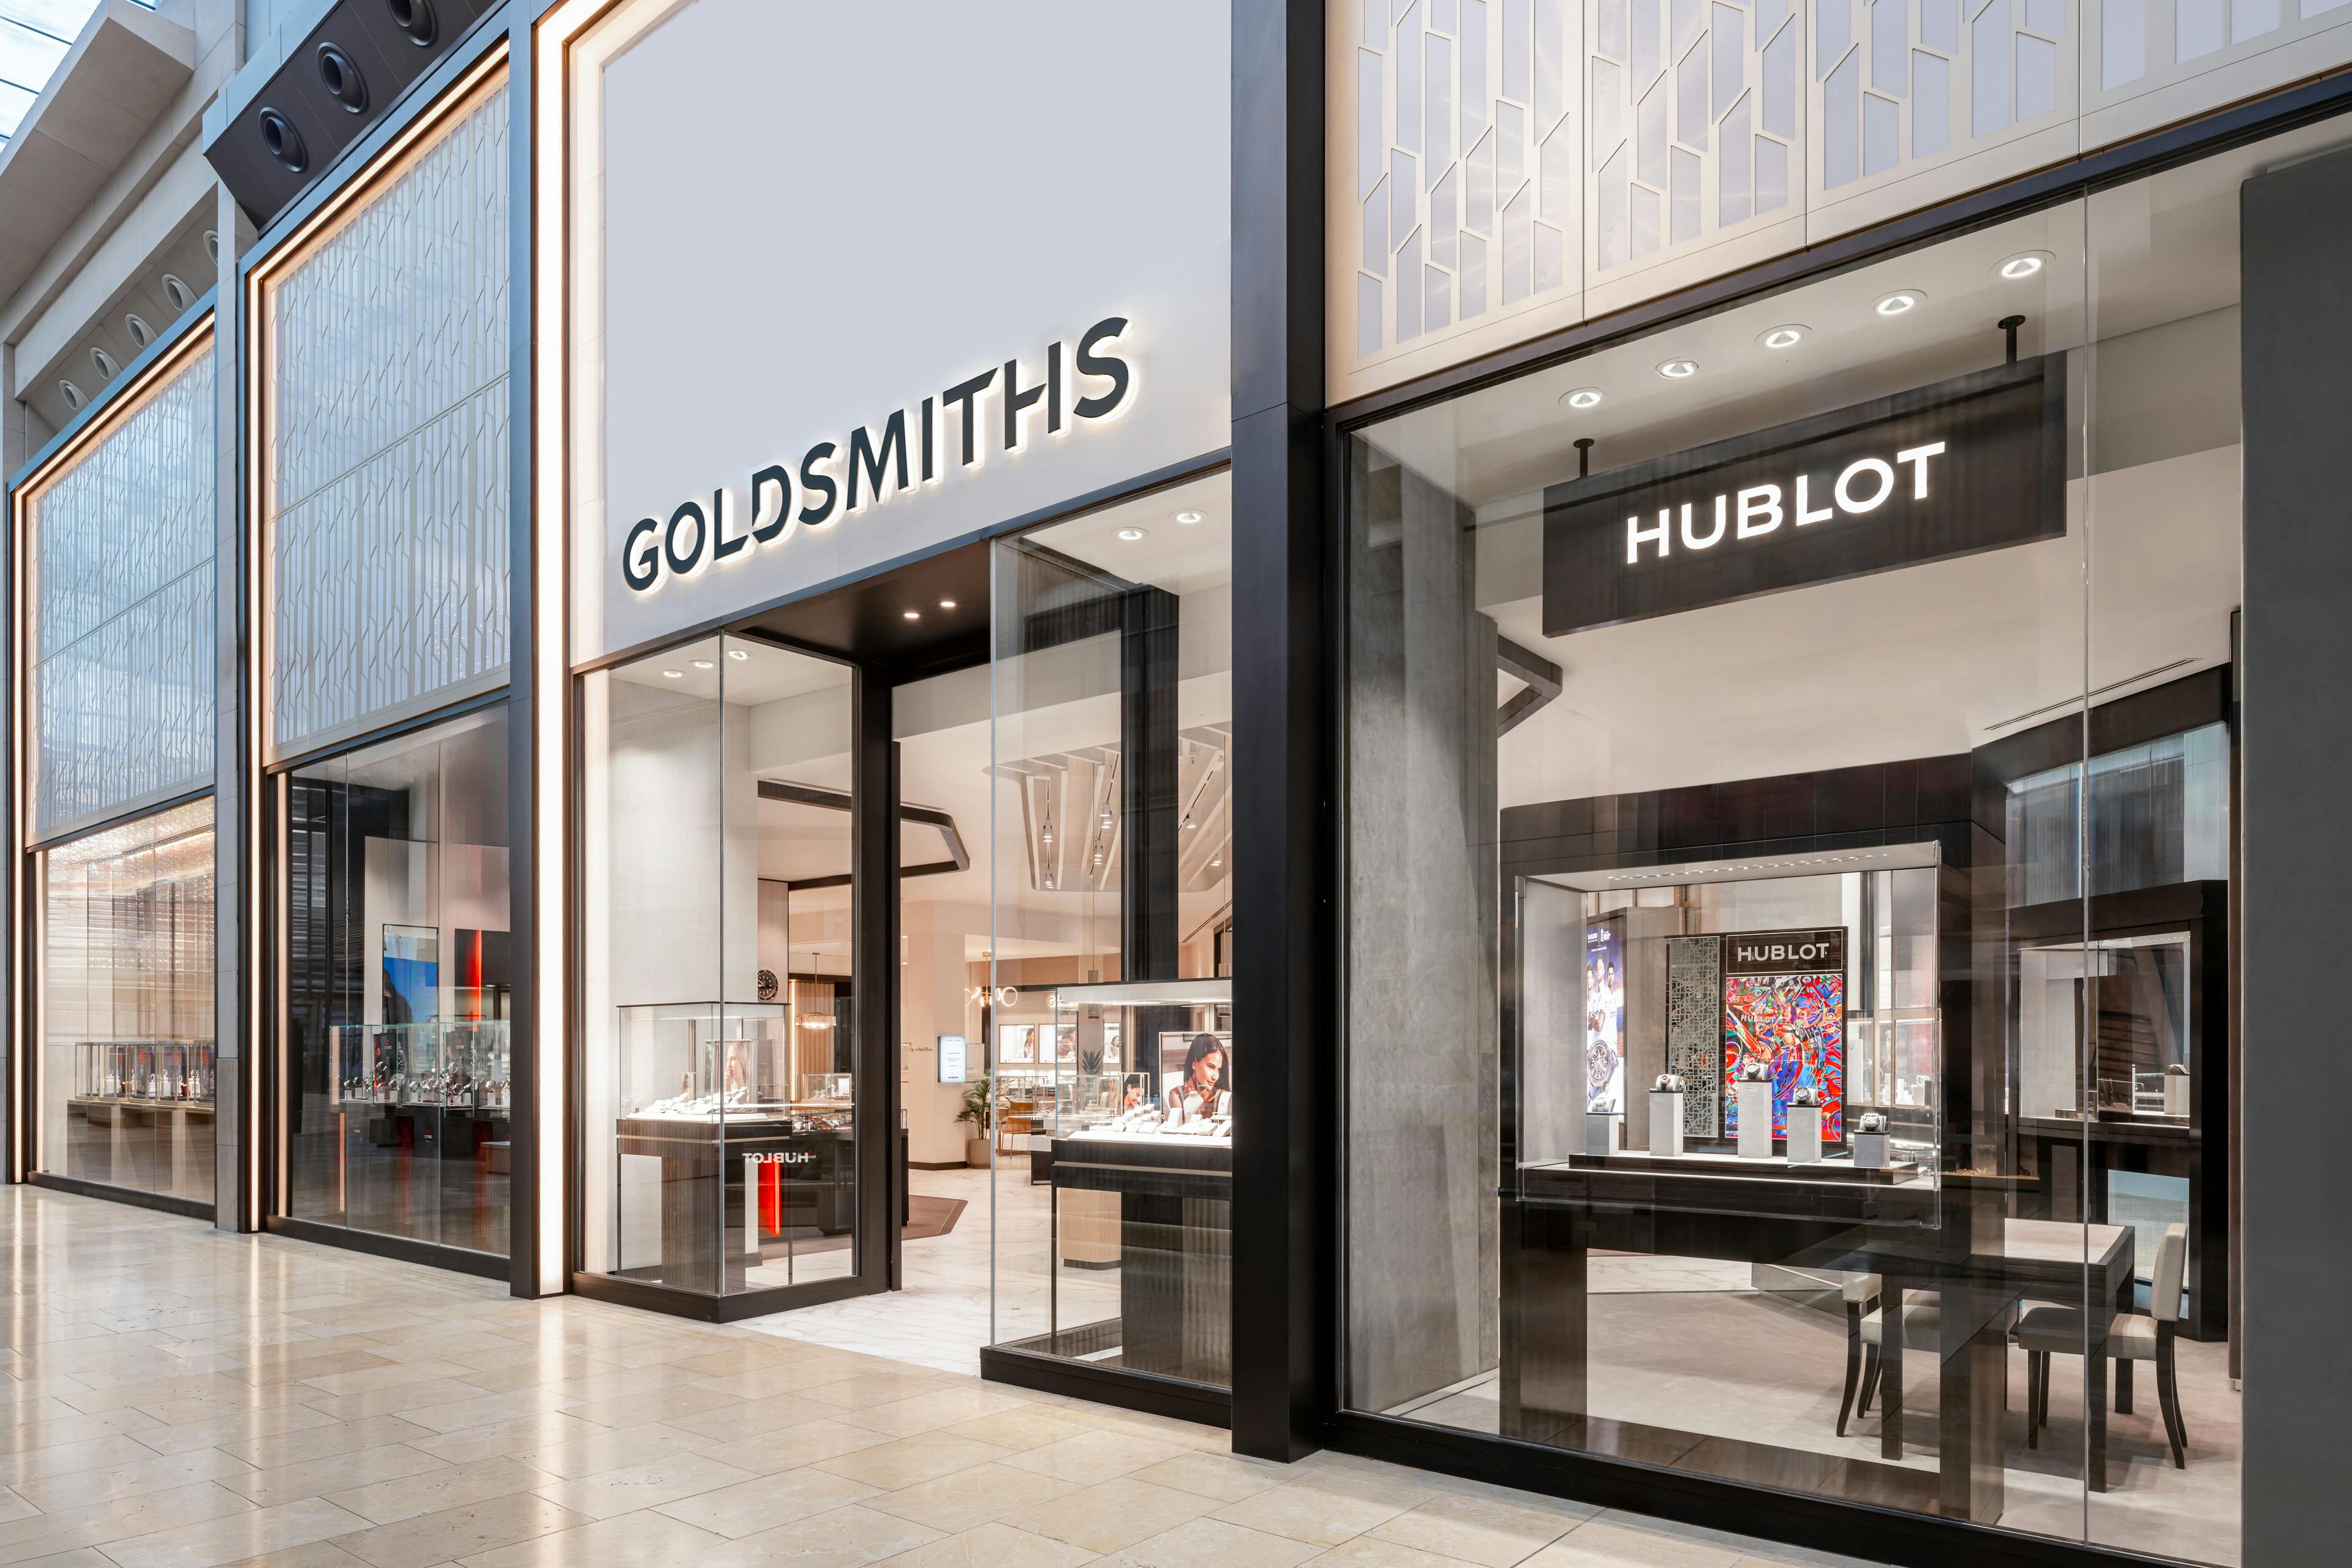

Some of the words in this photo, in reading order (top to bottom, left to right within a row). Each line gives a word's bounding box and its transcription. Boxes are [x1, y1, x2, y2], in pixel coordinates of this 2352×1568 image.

[623, 317, 1129, 591] GOLDSMITHS
[1627, 441, 1945, 564] HUBLOT
[1738, 943, 1829, 961] HUBLOT
